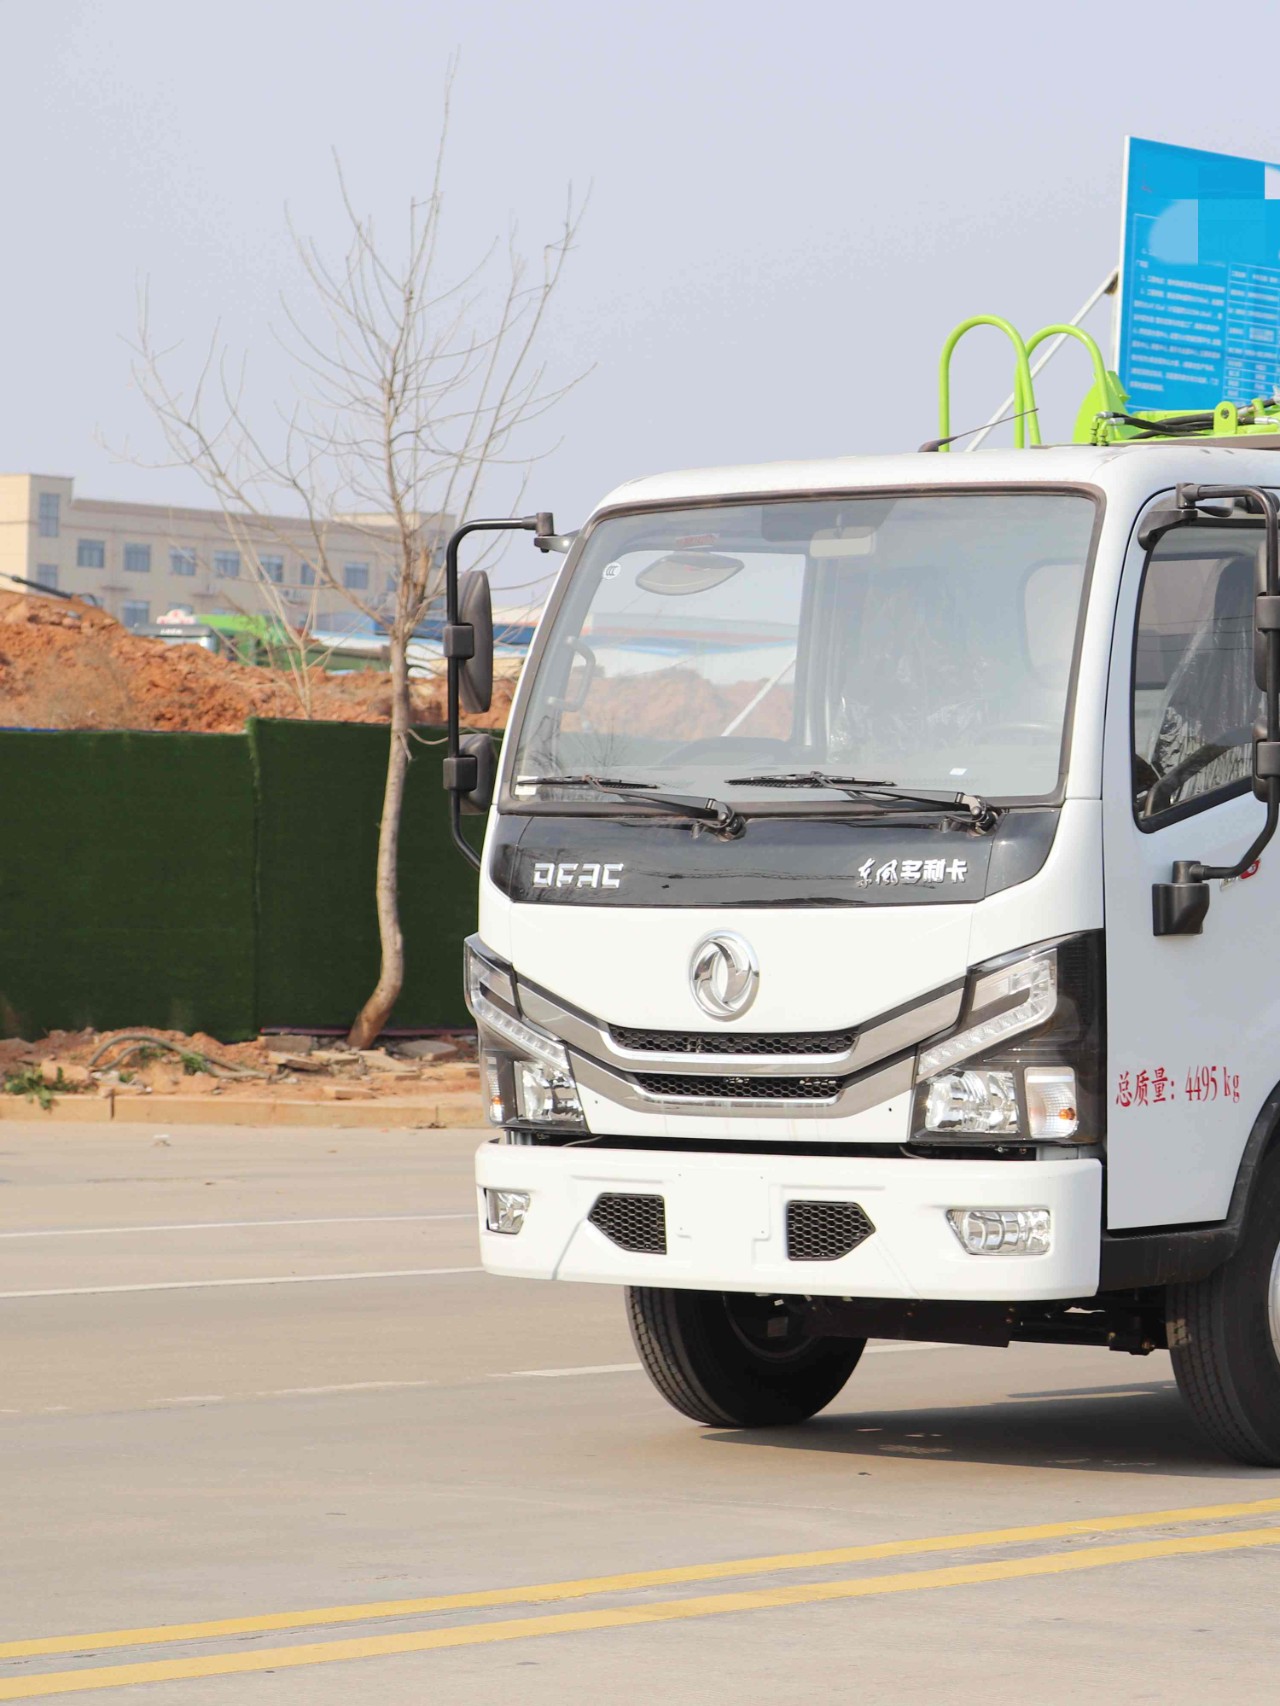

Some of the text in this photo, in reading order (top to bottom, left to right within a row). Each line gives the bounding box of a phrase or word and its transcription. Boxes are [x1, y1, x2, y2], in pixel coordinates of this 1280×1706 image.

[533, 862, 625, 889] DFAC
[857, 857, 968, 888] 东风多利卡
